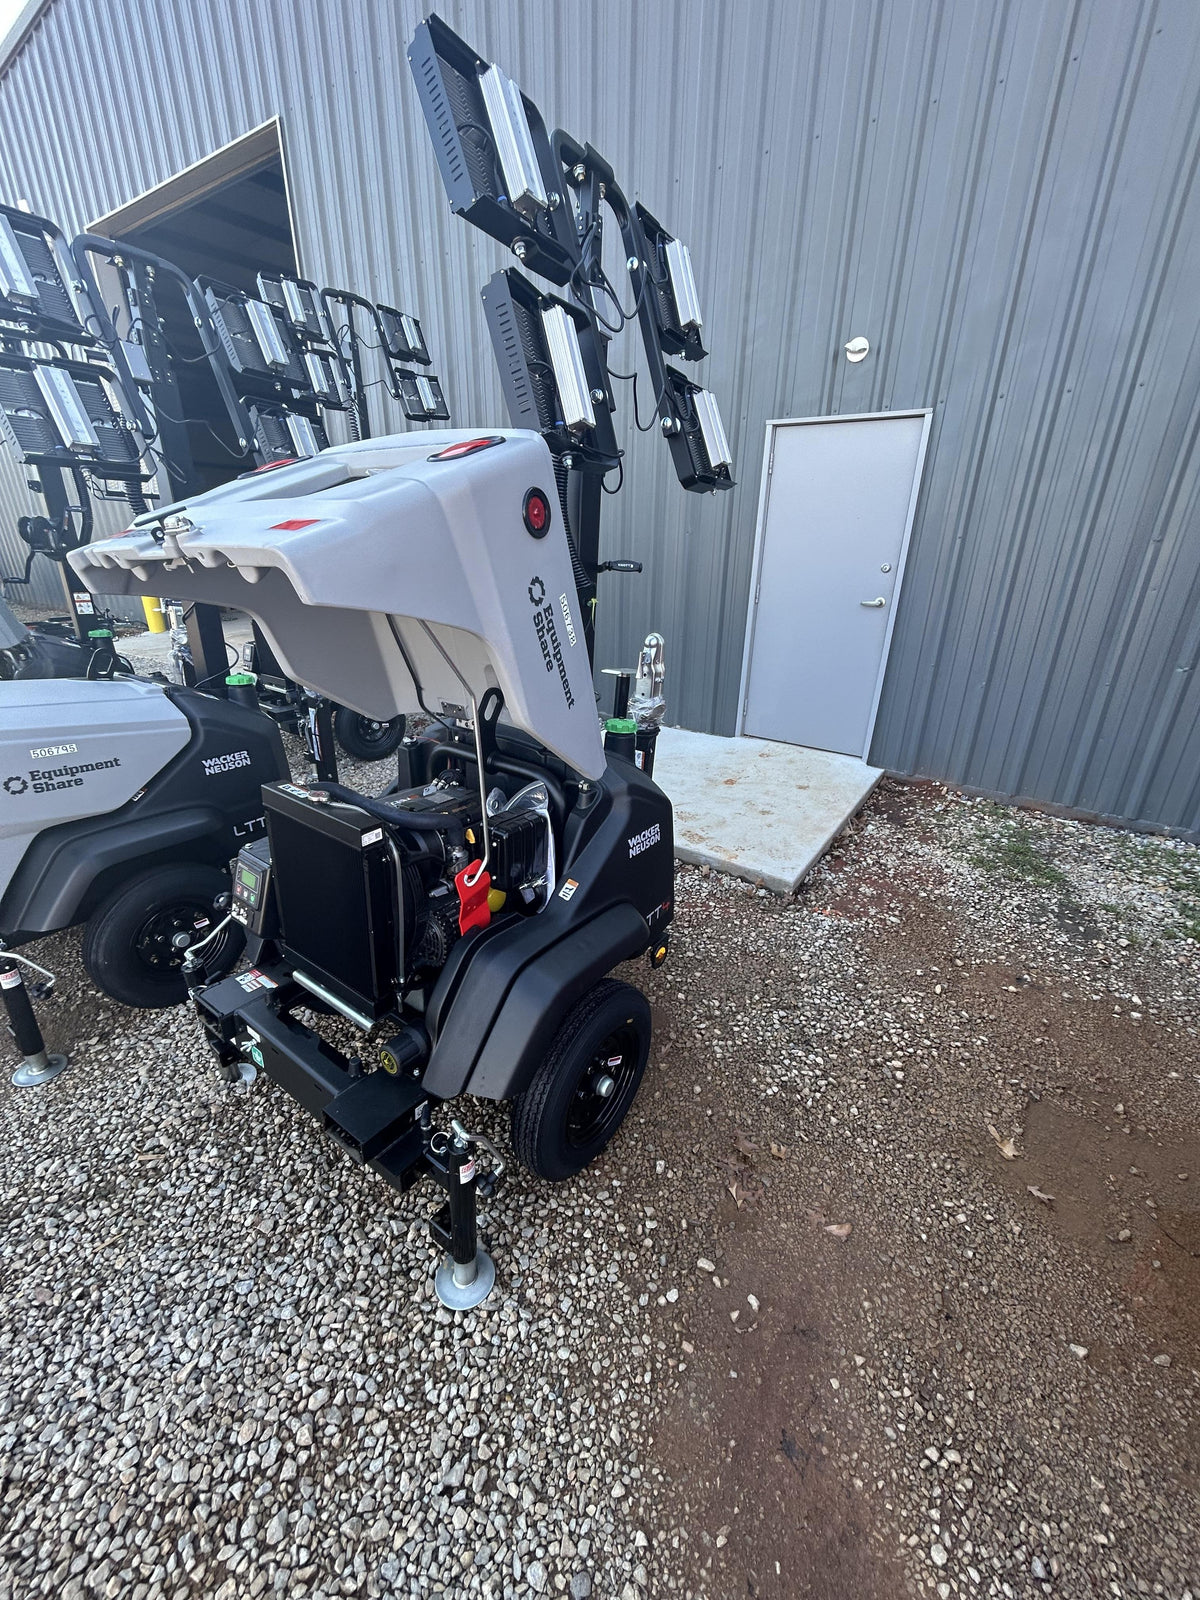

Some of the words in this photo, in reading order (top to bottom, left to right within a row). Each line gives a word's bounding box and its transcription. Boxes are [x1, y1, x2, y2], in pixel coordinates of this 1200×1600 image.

[533, 611, 554, 673] Share
[543, 603, 575, 710] Equipment
[30, 744, 78, 758] 506795
[202, 750, 250, 768] WACKER
[28, 757, 122, 781] Equipment
[204, 758, 252, 776] NEUSON
[32, 777, 84, 794] Share
[233, 816, 266, 837] LTT
[628, 823, 661, 848] WACKER
[628, 831, 661, 858] NEUSON
[646, 901, 670, 926] TT4
